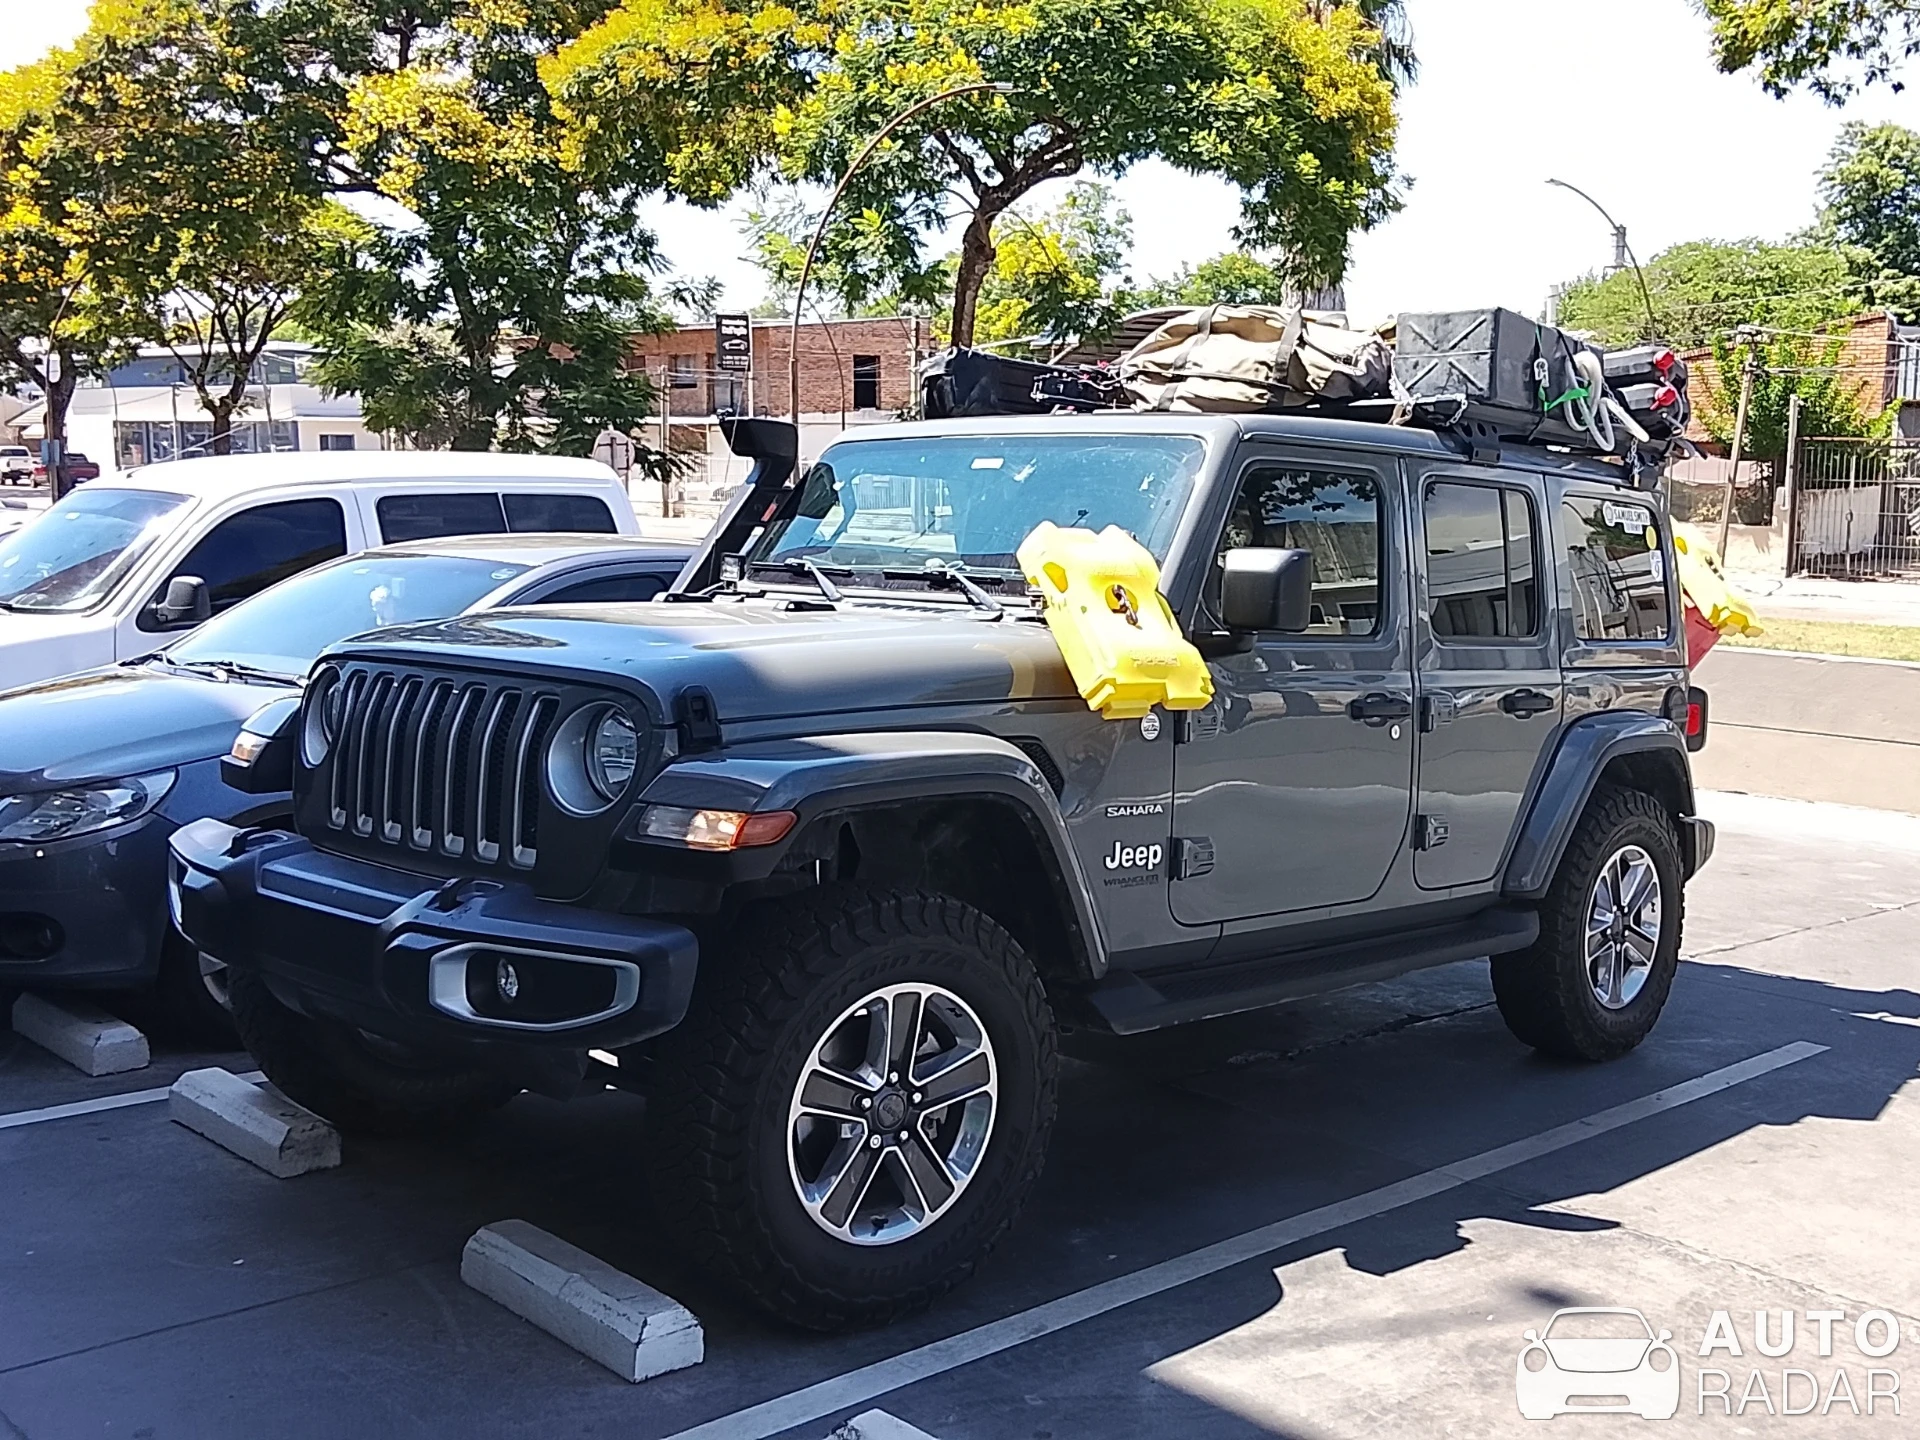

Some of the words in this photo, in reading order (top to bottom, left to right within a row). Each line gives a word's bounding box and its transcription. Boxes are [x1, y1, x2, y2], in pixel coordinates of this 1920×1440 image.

[1613, 508, 1633, 523] SAMUEL
[1106, 803, 1164, 817] SAHARA
[1104, 841, 1162, 870] Jeep
[1103, 873, 1159, 887] WRANGLER
